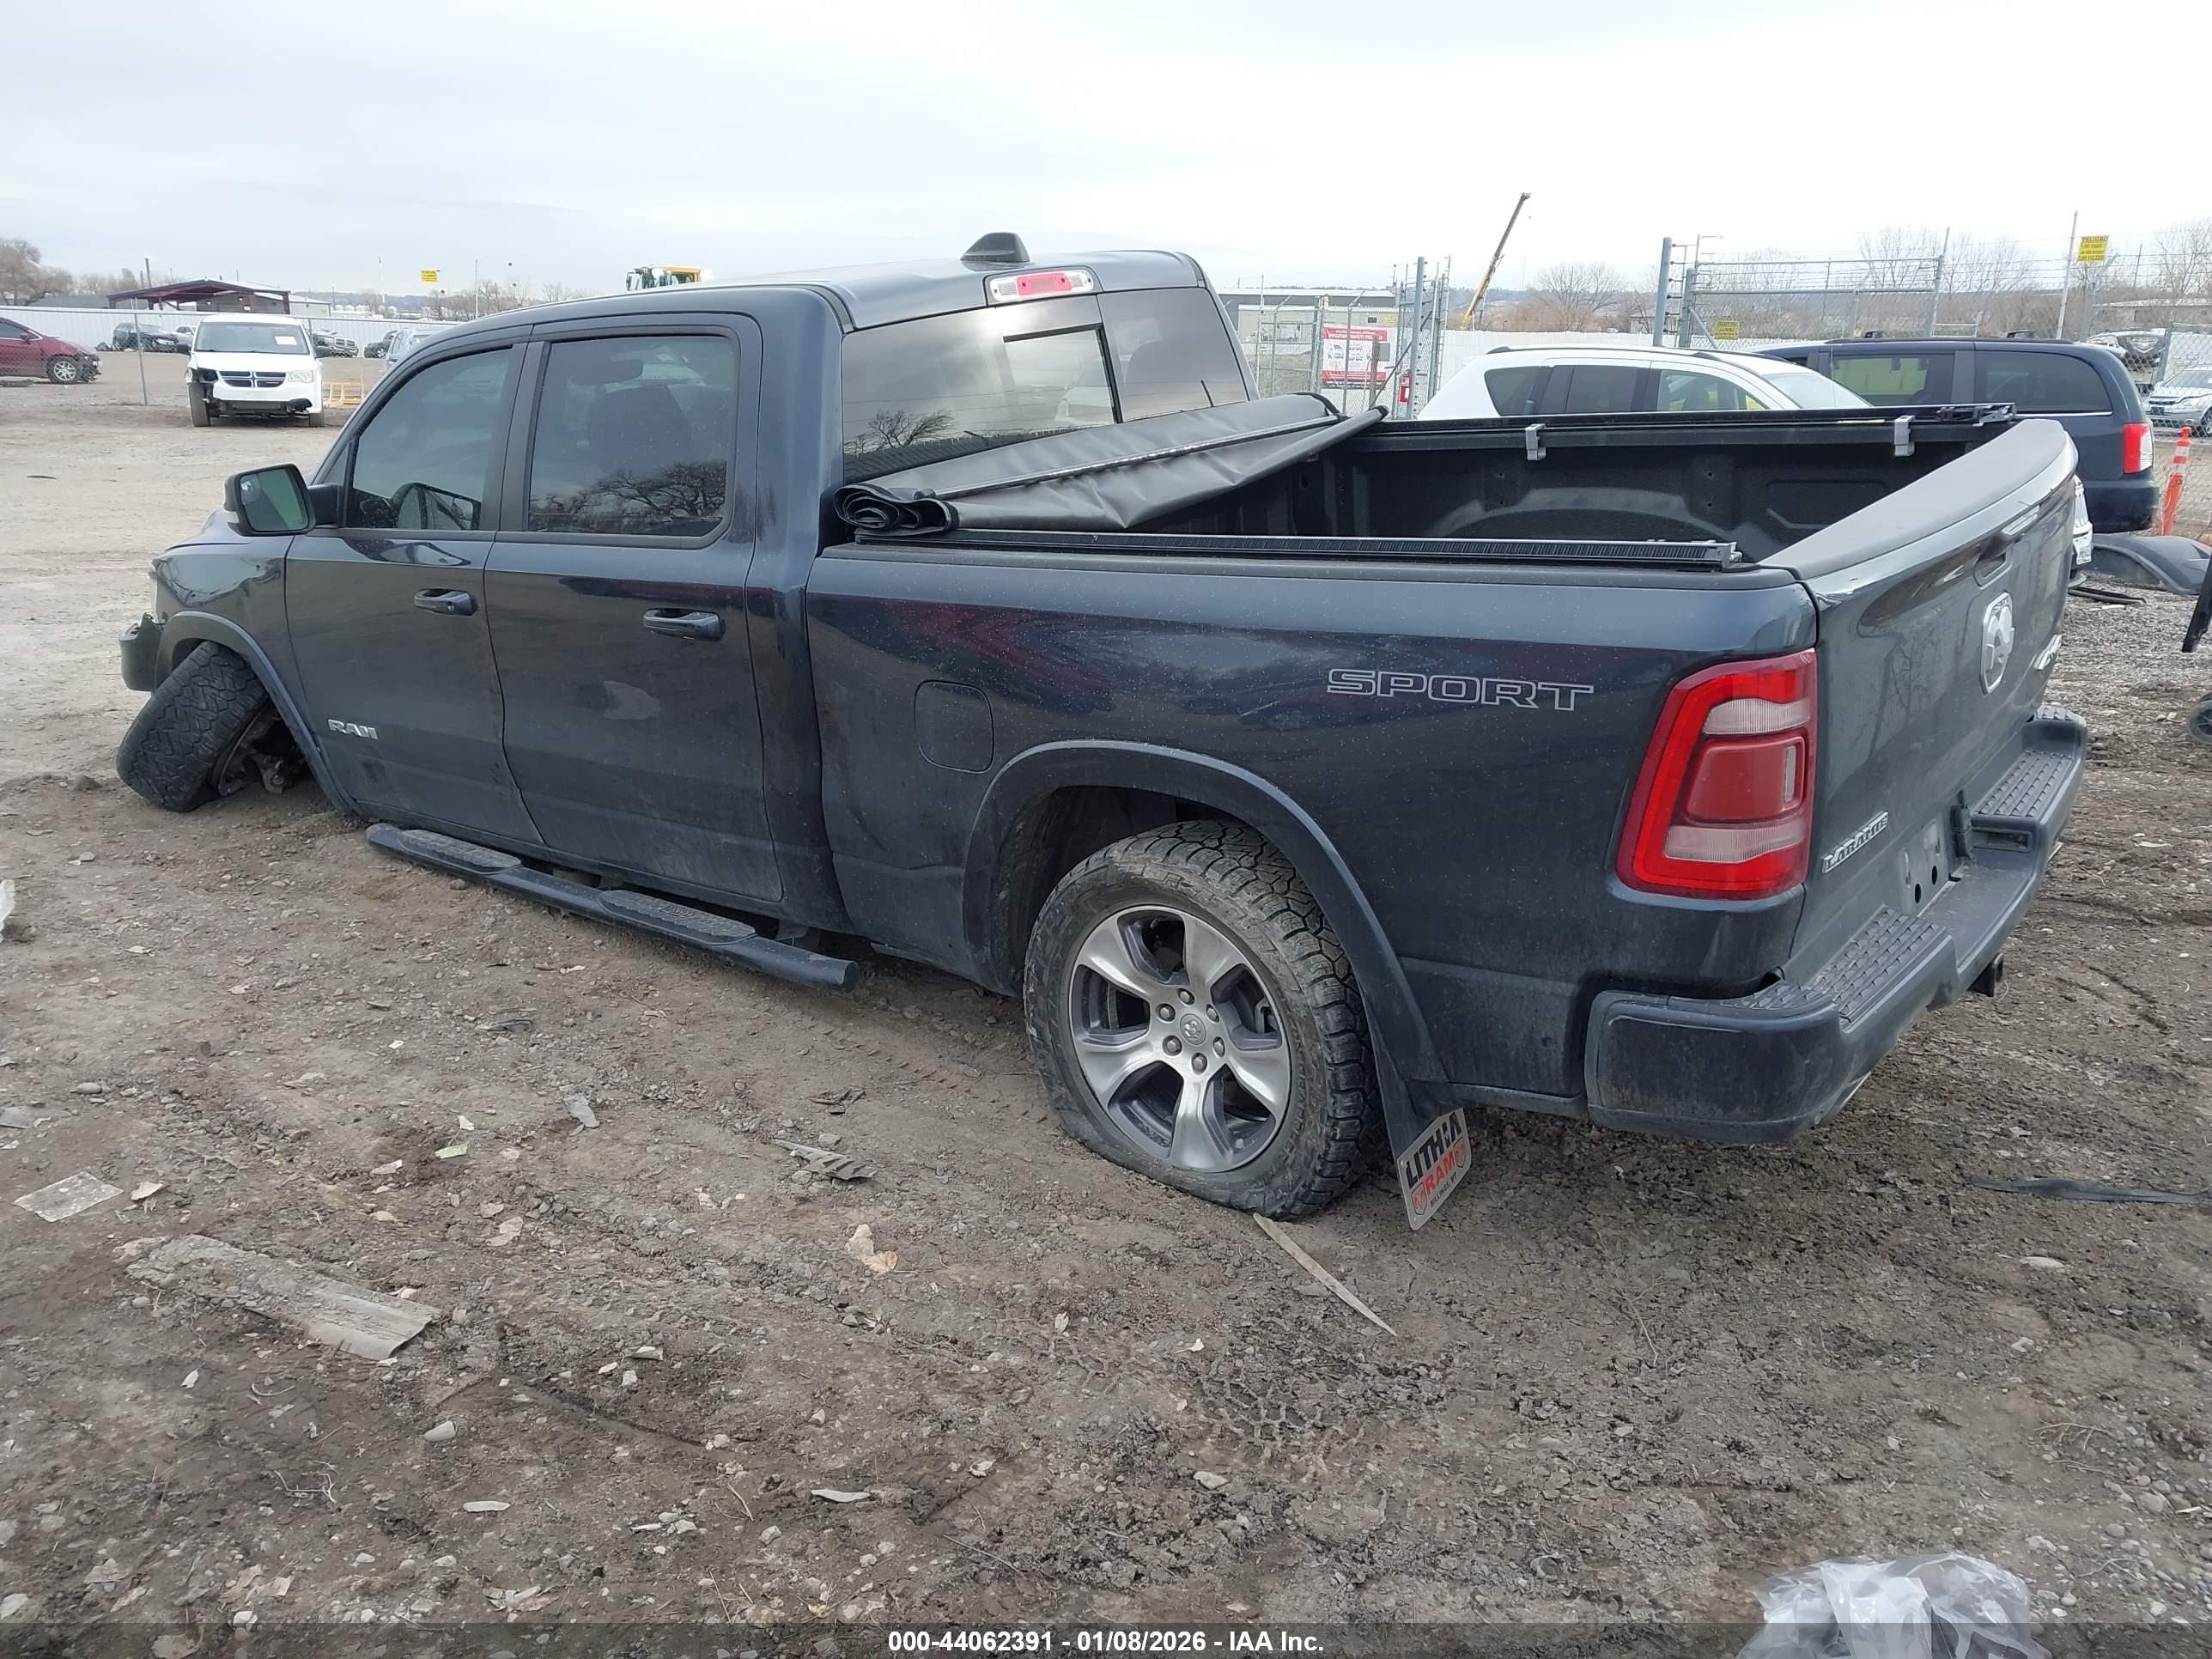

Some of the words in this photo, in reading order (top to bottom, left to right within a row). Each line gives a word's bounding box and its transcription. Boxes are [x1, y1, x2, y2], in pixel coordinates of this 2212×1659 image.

[1327, 669, 1594, 711] SPORT
[328, 719, 378, 740] RAM
[1424, 1151, 1456, 1195] RAM
